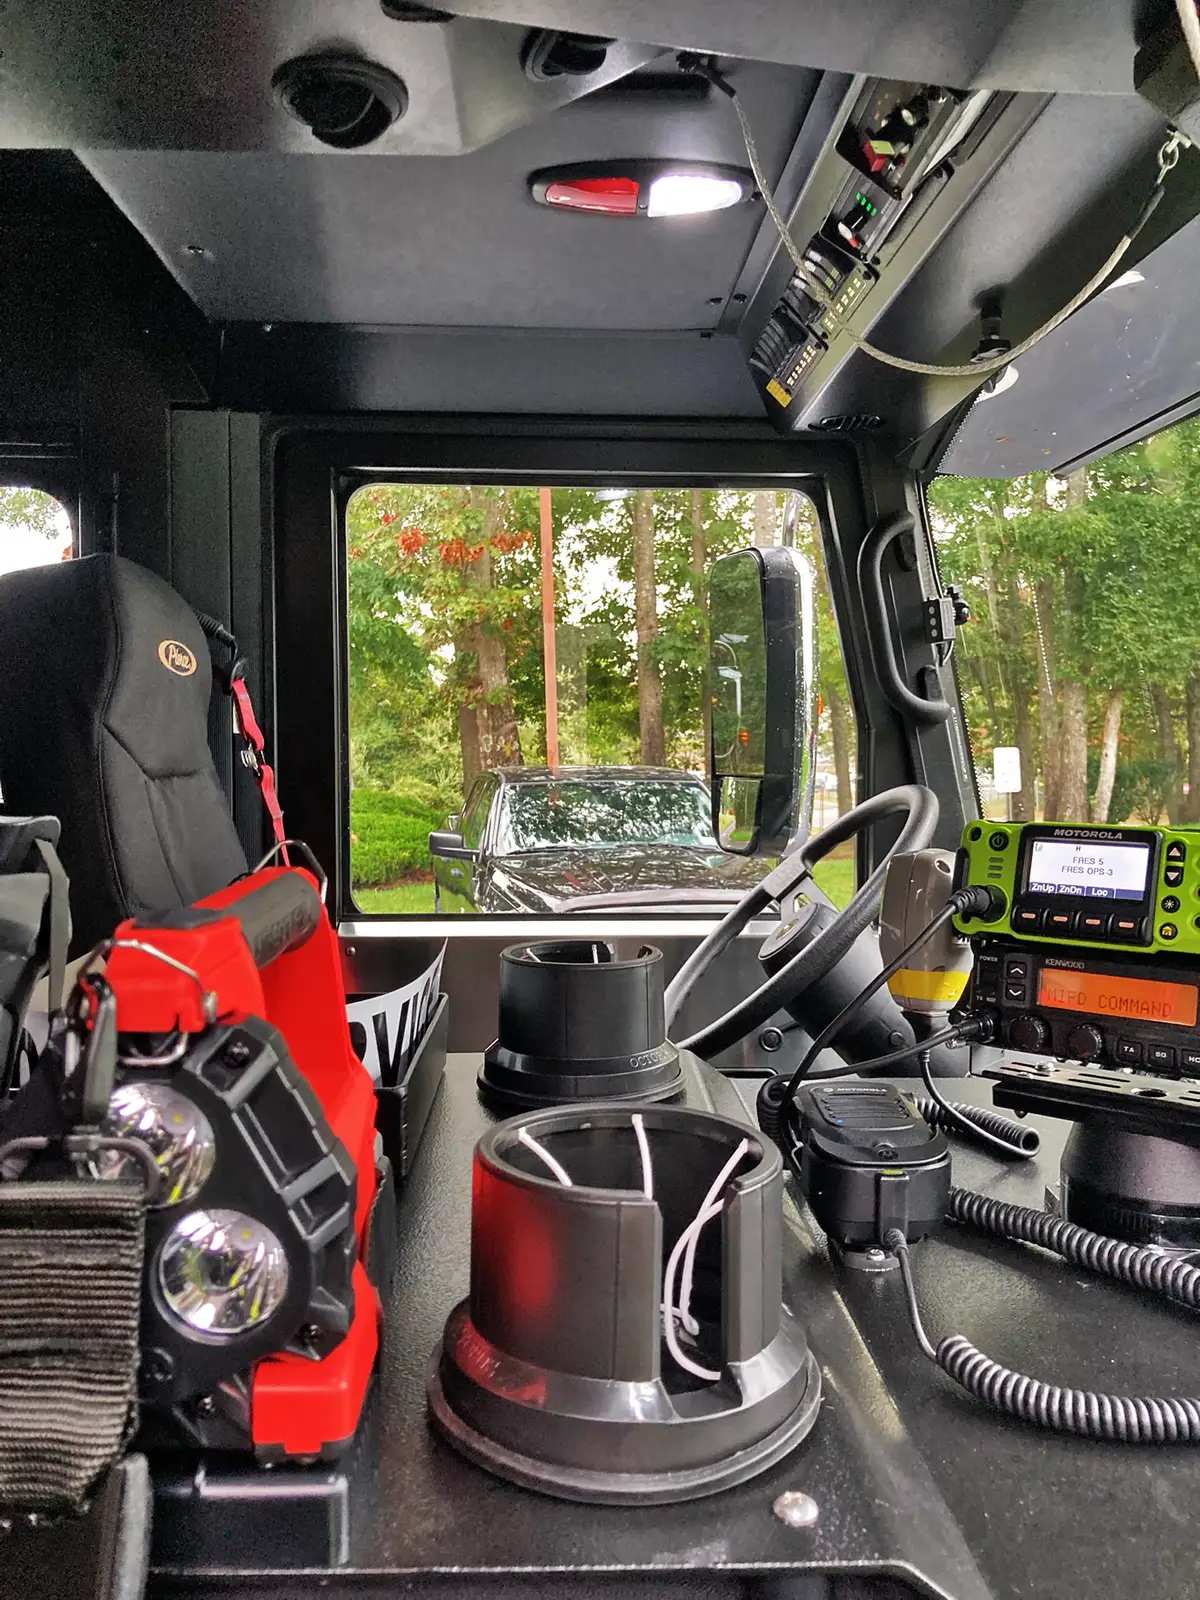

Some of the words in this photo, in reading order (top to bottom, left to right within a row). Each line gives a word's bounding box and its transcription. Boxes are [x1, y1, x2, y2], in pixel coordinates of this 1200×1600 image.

[1053, 829, 1123, 840] MOTOROLA
[1072, 856, 1096, 866] FRES
[1098, 858, 1104, 866] 5
[1061, 865, 1084, 875] FRES
[1031, 883, 1055, 894] ZnUp
[1060, 884, 1082, 895] ZnDn
[1045, 958, 1085, 969] KENWOOD
[1098, 994, 1172, 1018] COMMAND
[1123, 1045, 1135, 1053] TA
